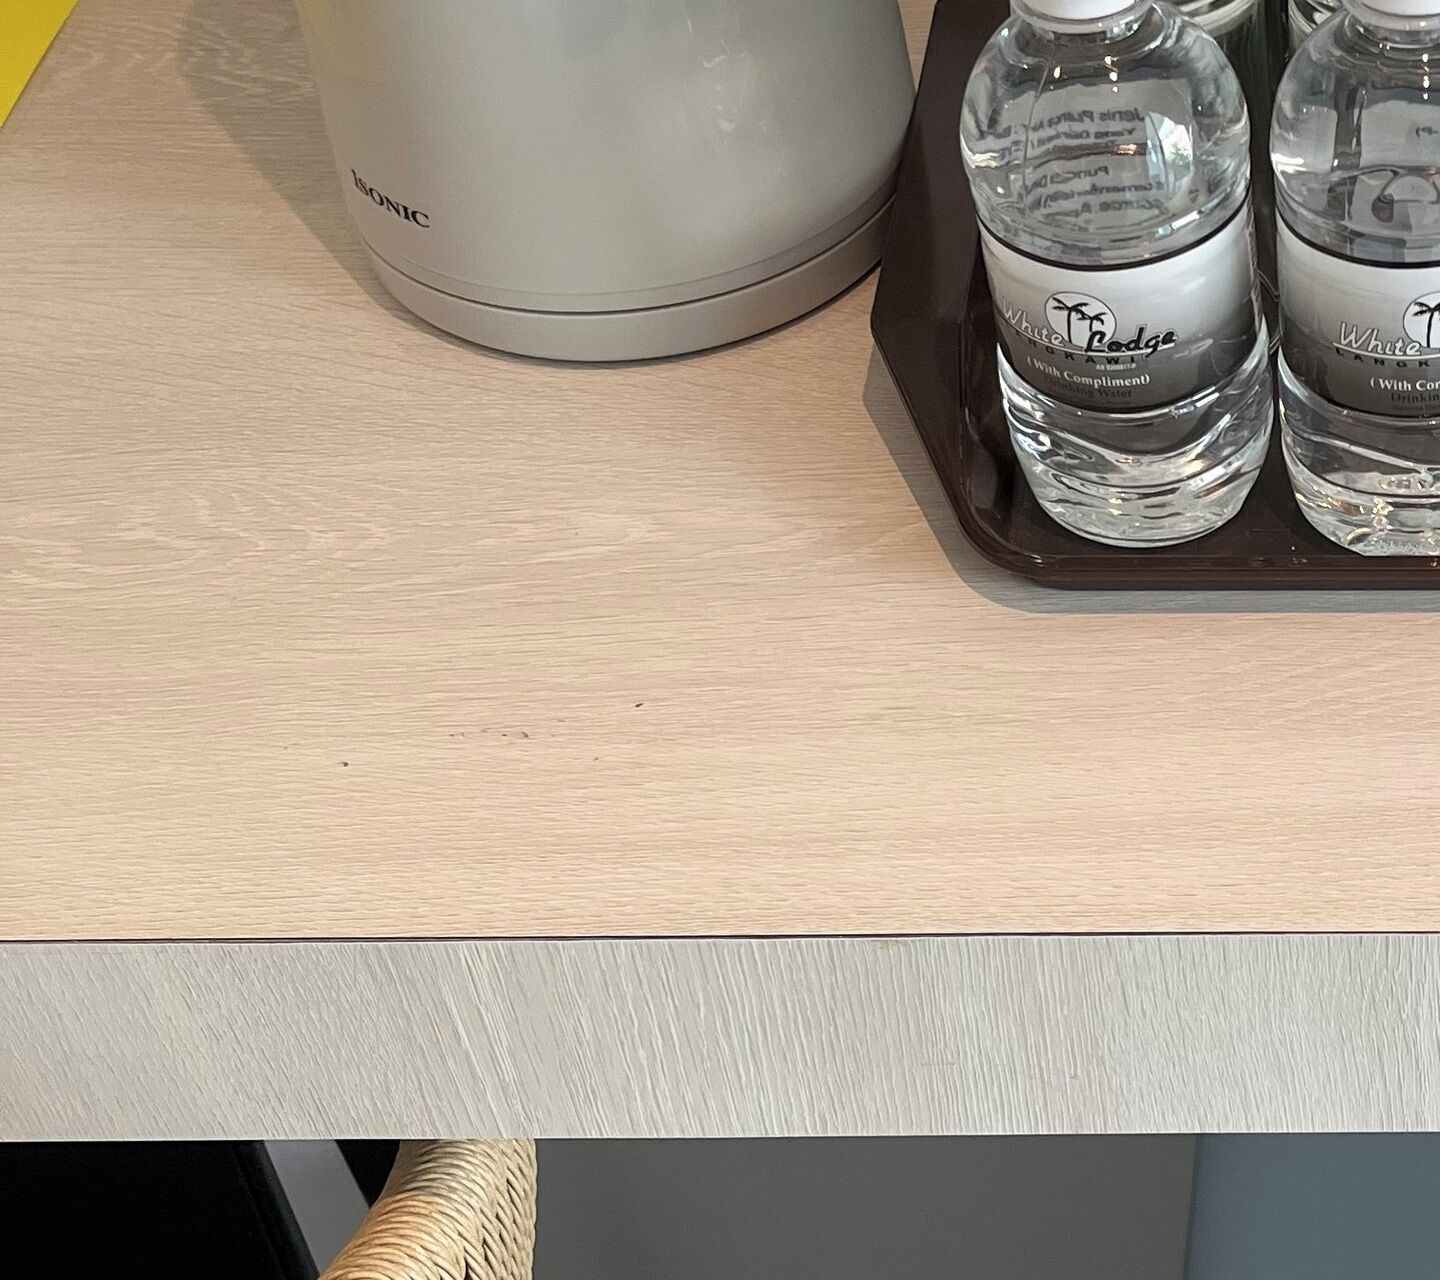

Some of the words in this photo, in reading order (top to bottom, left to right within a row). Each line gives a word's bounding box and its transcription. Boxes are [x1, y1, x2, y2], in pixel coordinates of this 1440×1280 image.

[1002, 298, 1065, 348] White
[1083, 323, 1178, 359] Lodge
[1338, 321, 1422, 356] White
[1063, 370, 1151, 390] Compliment)
